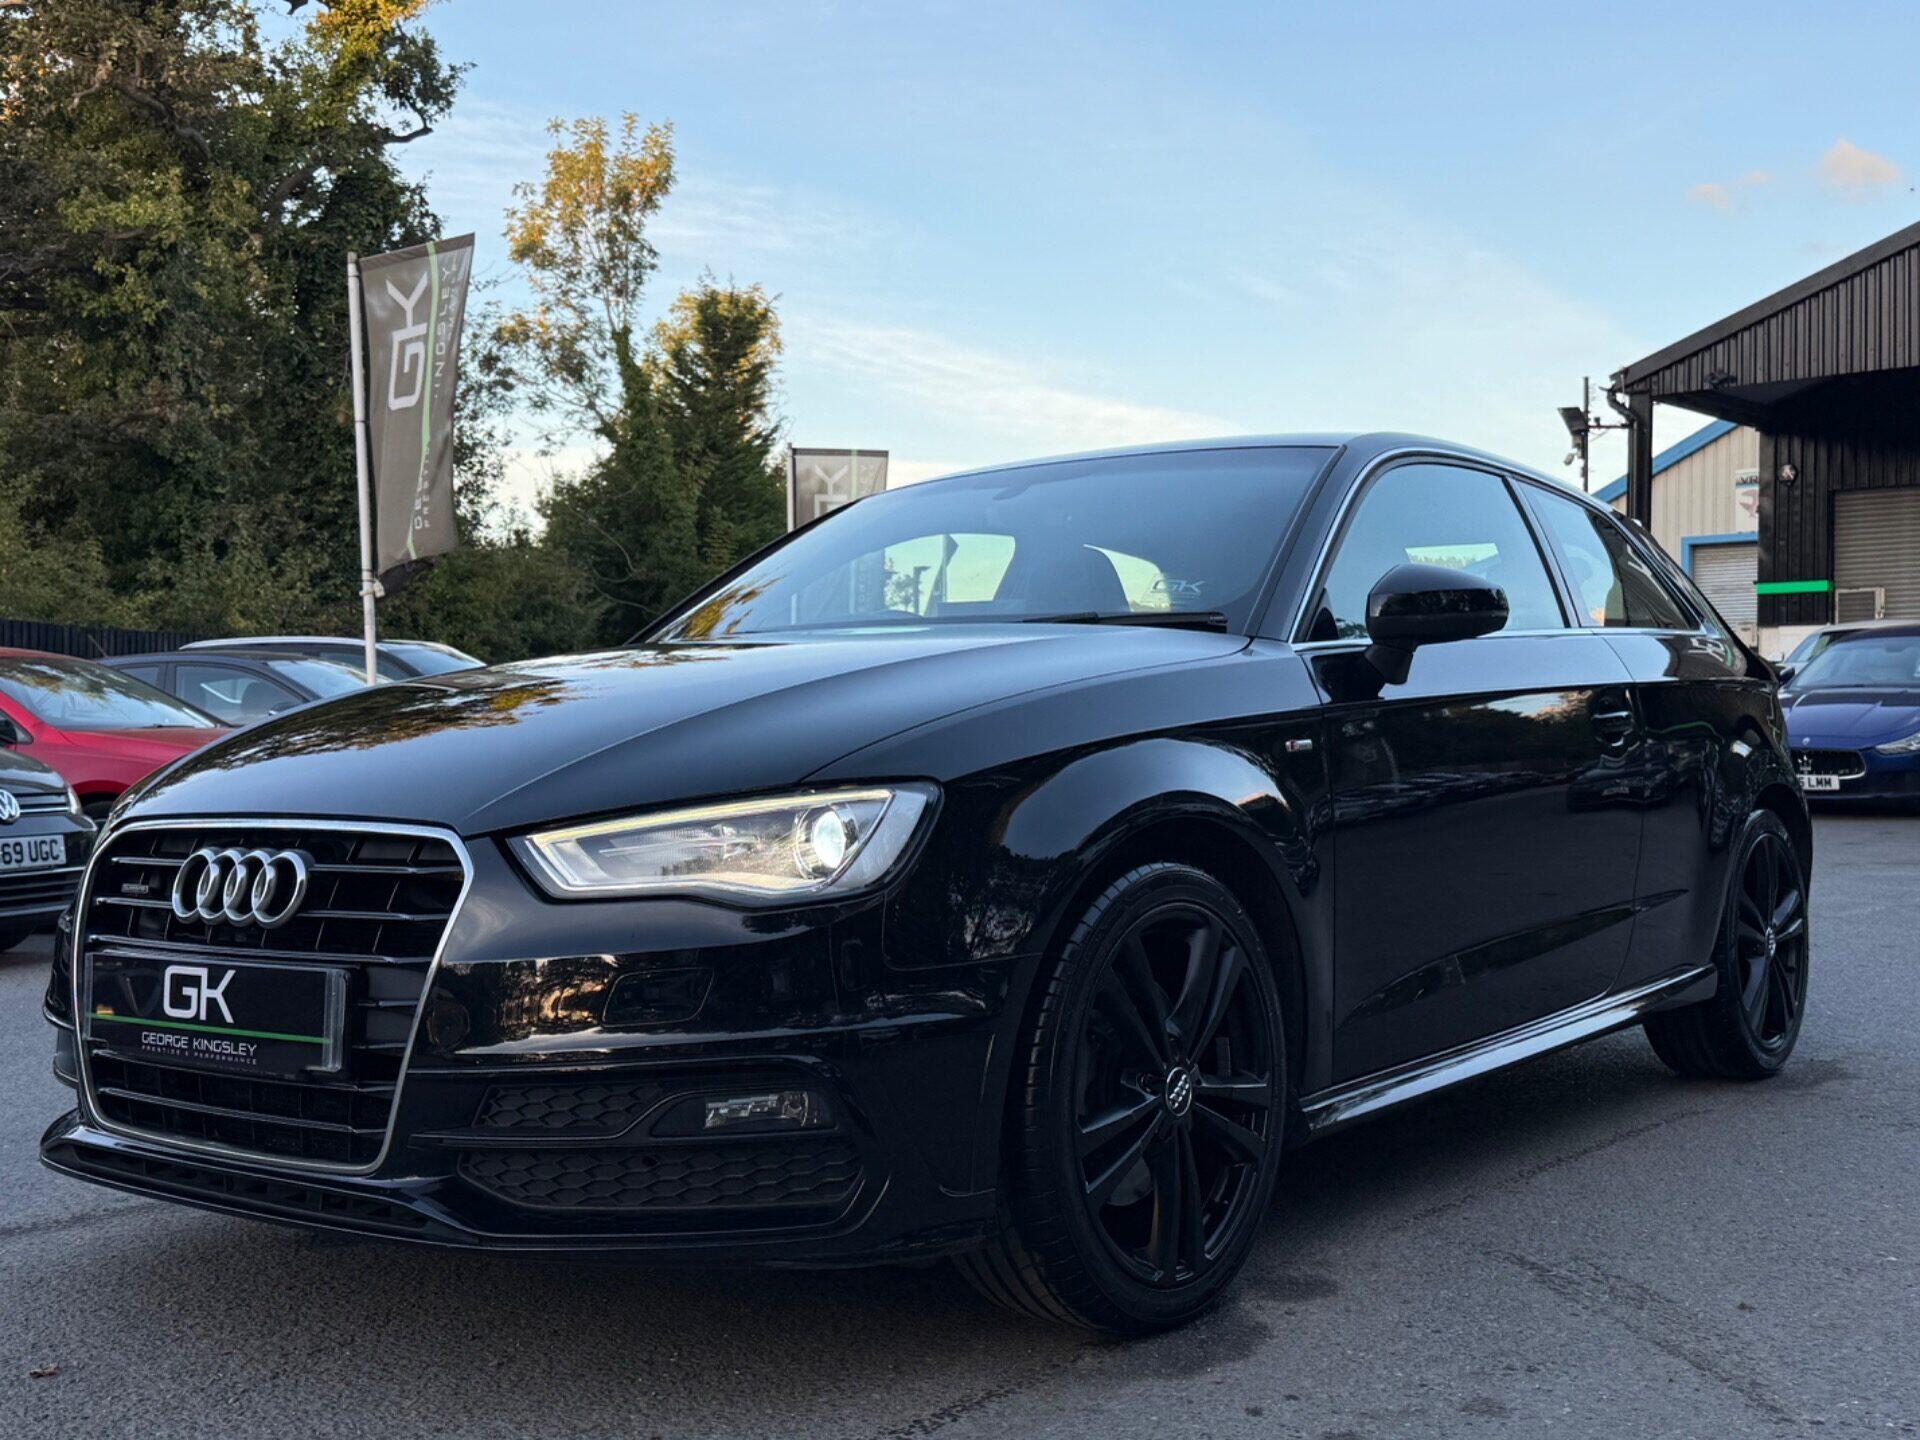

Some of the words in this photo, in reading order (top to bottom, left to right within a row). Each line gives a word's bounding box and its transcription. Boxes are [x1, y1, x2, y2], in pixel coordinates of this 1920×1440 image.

[385, 271, 428, 411] GK
[28, 839, 60, 862] UGC
[163, 965, 236, 1024] GK
[141, 1031, 189, 1048] GEORGE
[192, 1038, 257, 1056] KINGSLEY
